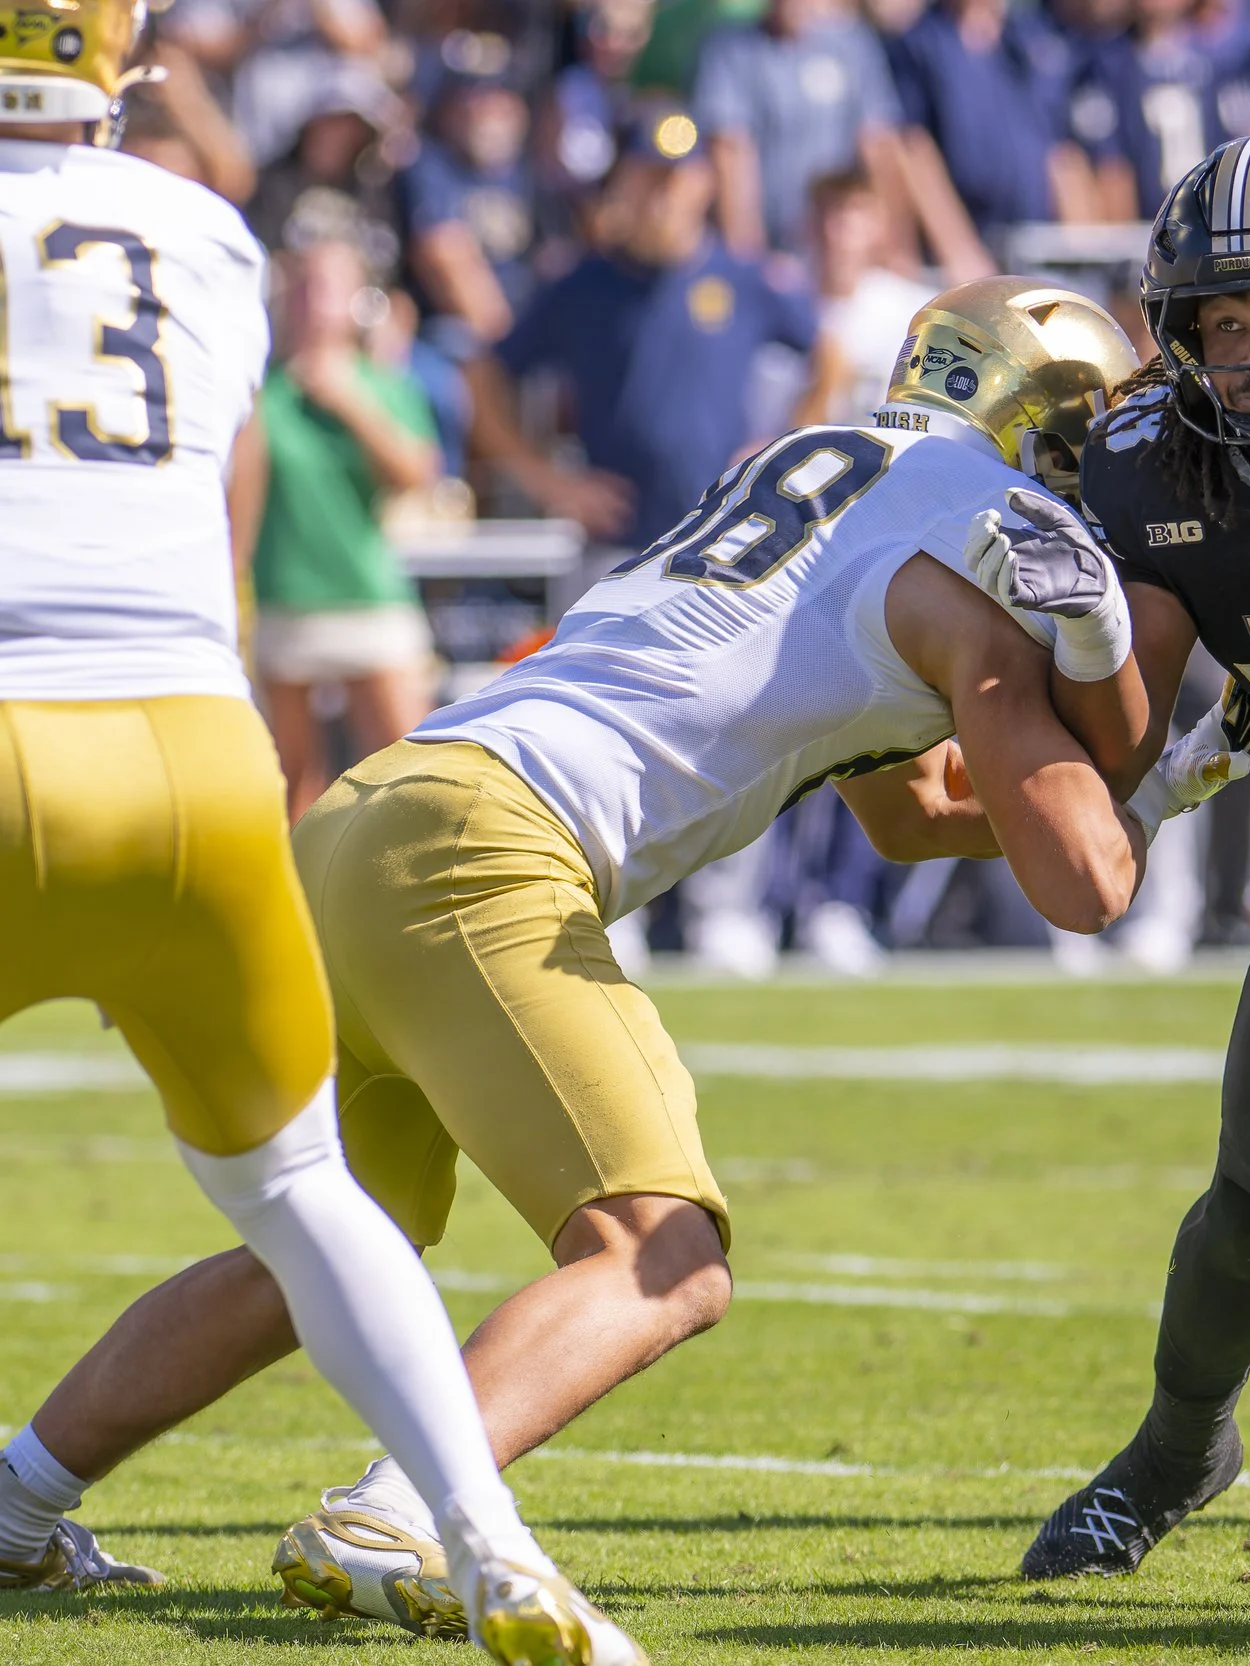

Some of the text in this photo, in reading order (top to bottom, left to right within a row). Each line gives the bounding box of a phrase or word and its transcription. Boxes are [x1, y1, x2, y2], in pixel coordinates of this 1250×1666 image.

[0, 217, 176, 468] 3
[924, 355, 948, 365] NCAA
[876, 411, 930, 433] RISH
